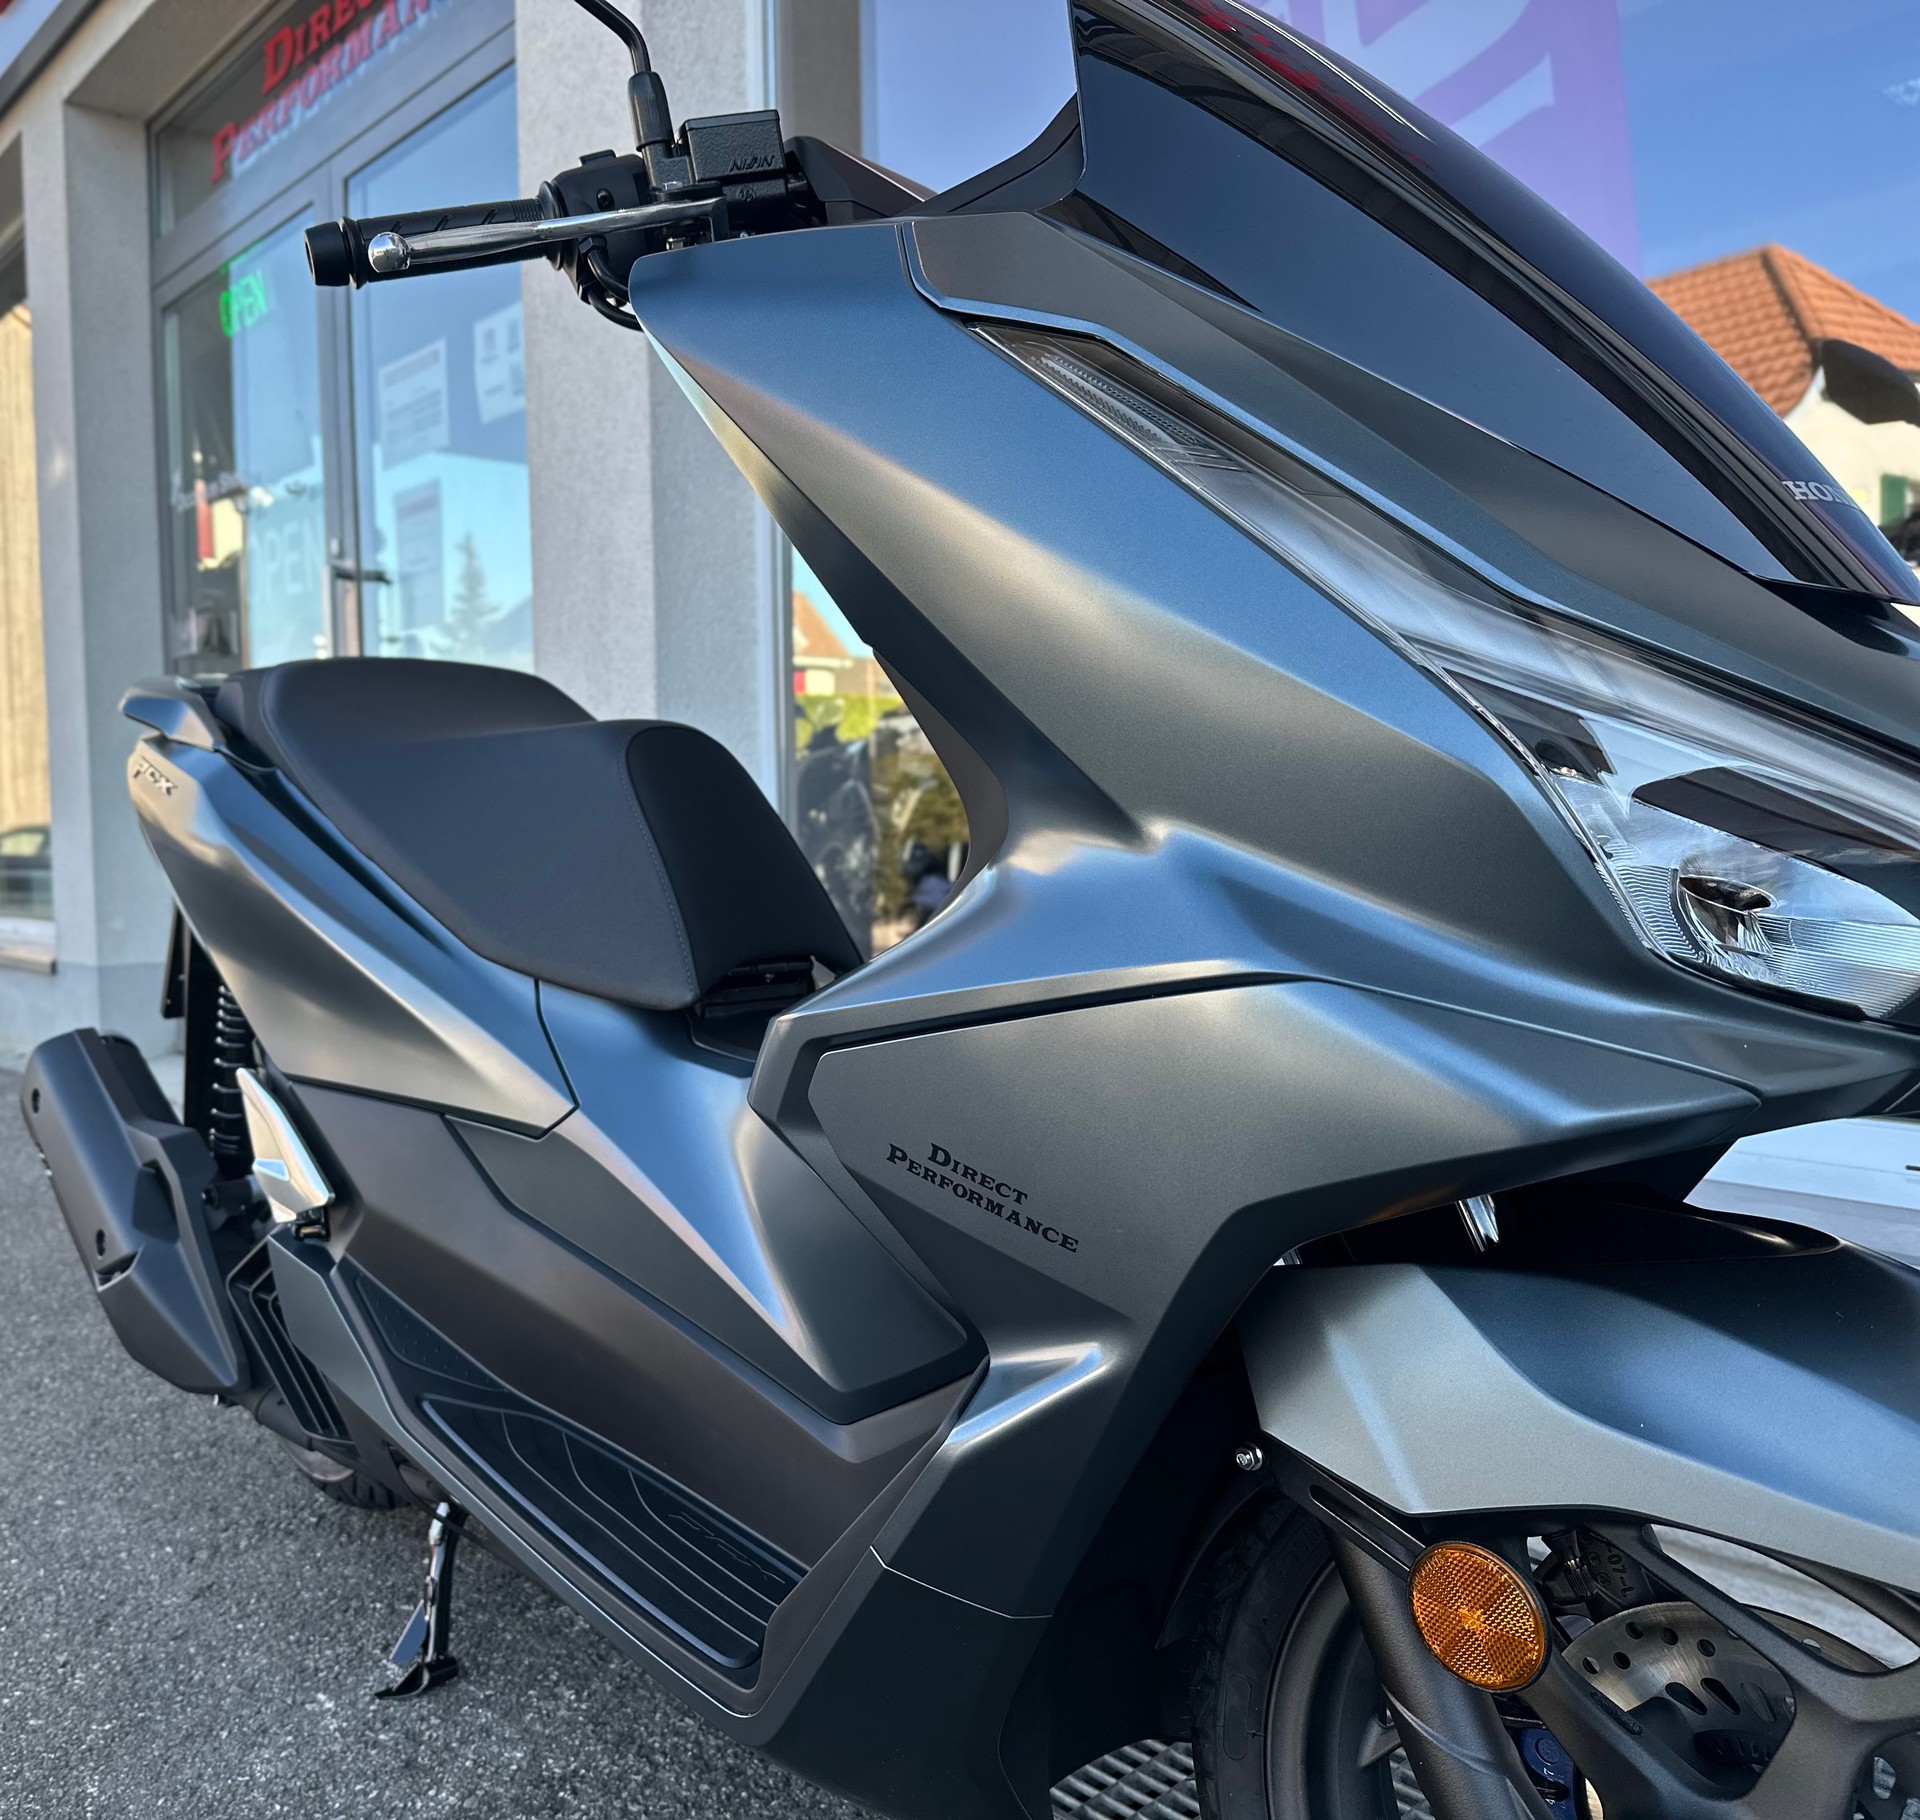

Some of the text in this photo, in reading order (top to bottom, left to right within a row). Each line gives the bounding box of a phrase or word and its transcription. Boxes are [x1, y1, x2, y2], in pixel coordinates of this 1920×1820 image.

[262, 0, 374, 94] DIRE
[886, 1143, 1079, 1253] PERFORMANCE
[927, 1142, 1028, 1205] DIRECT
